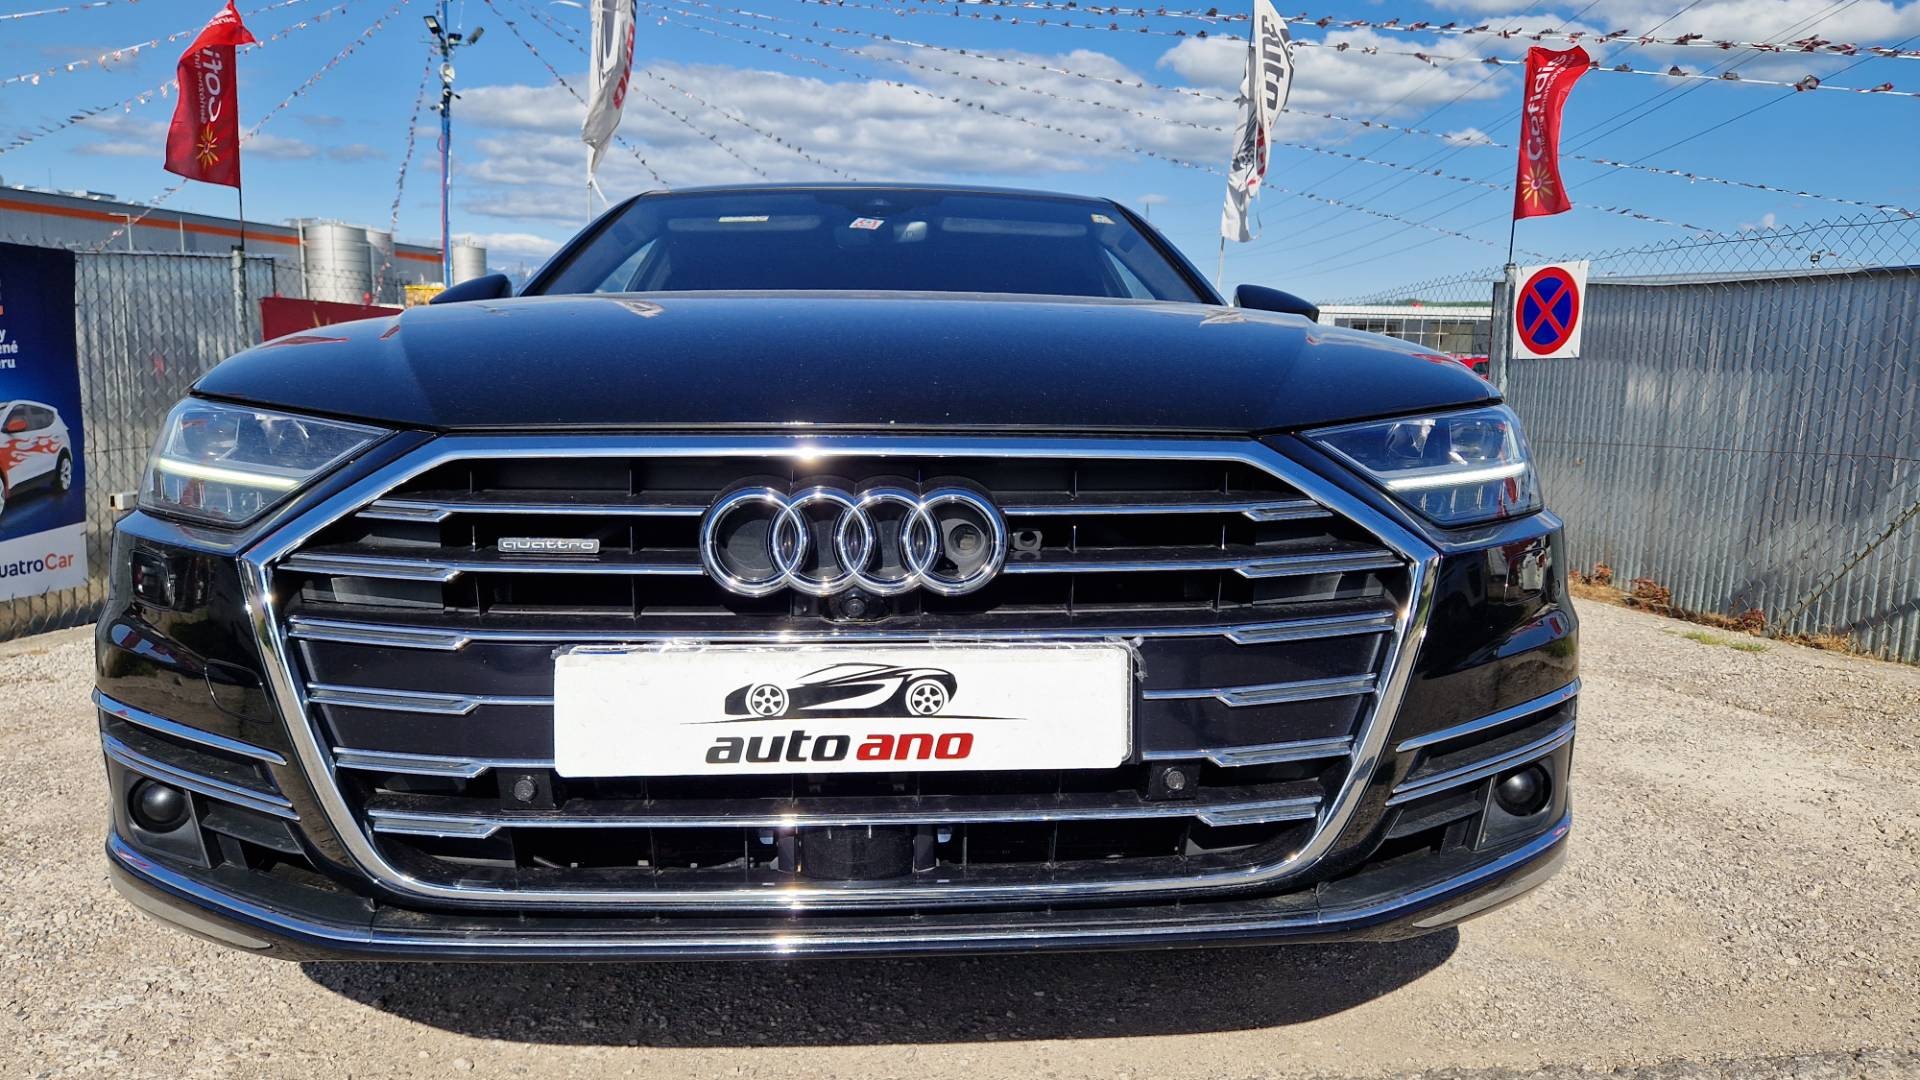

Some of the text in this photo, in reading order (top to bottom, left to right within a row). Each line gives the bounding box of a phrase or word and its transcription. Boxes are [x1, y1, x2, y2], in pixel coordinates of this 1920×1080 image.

[0, 358, 16, 369] ru
[502, 540, 594, 550] quattro
[705, 730, 974, 764] auto ano
